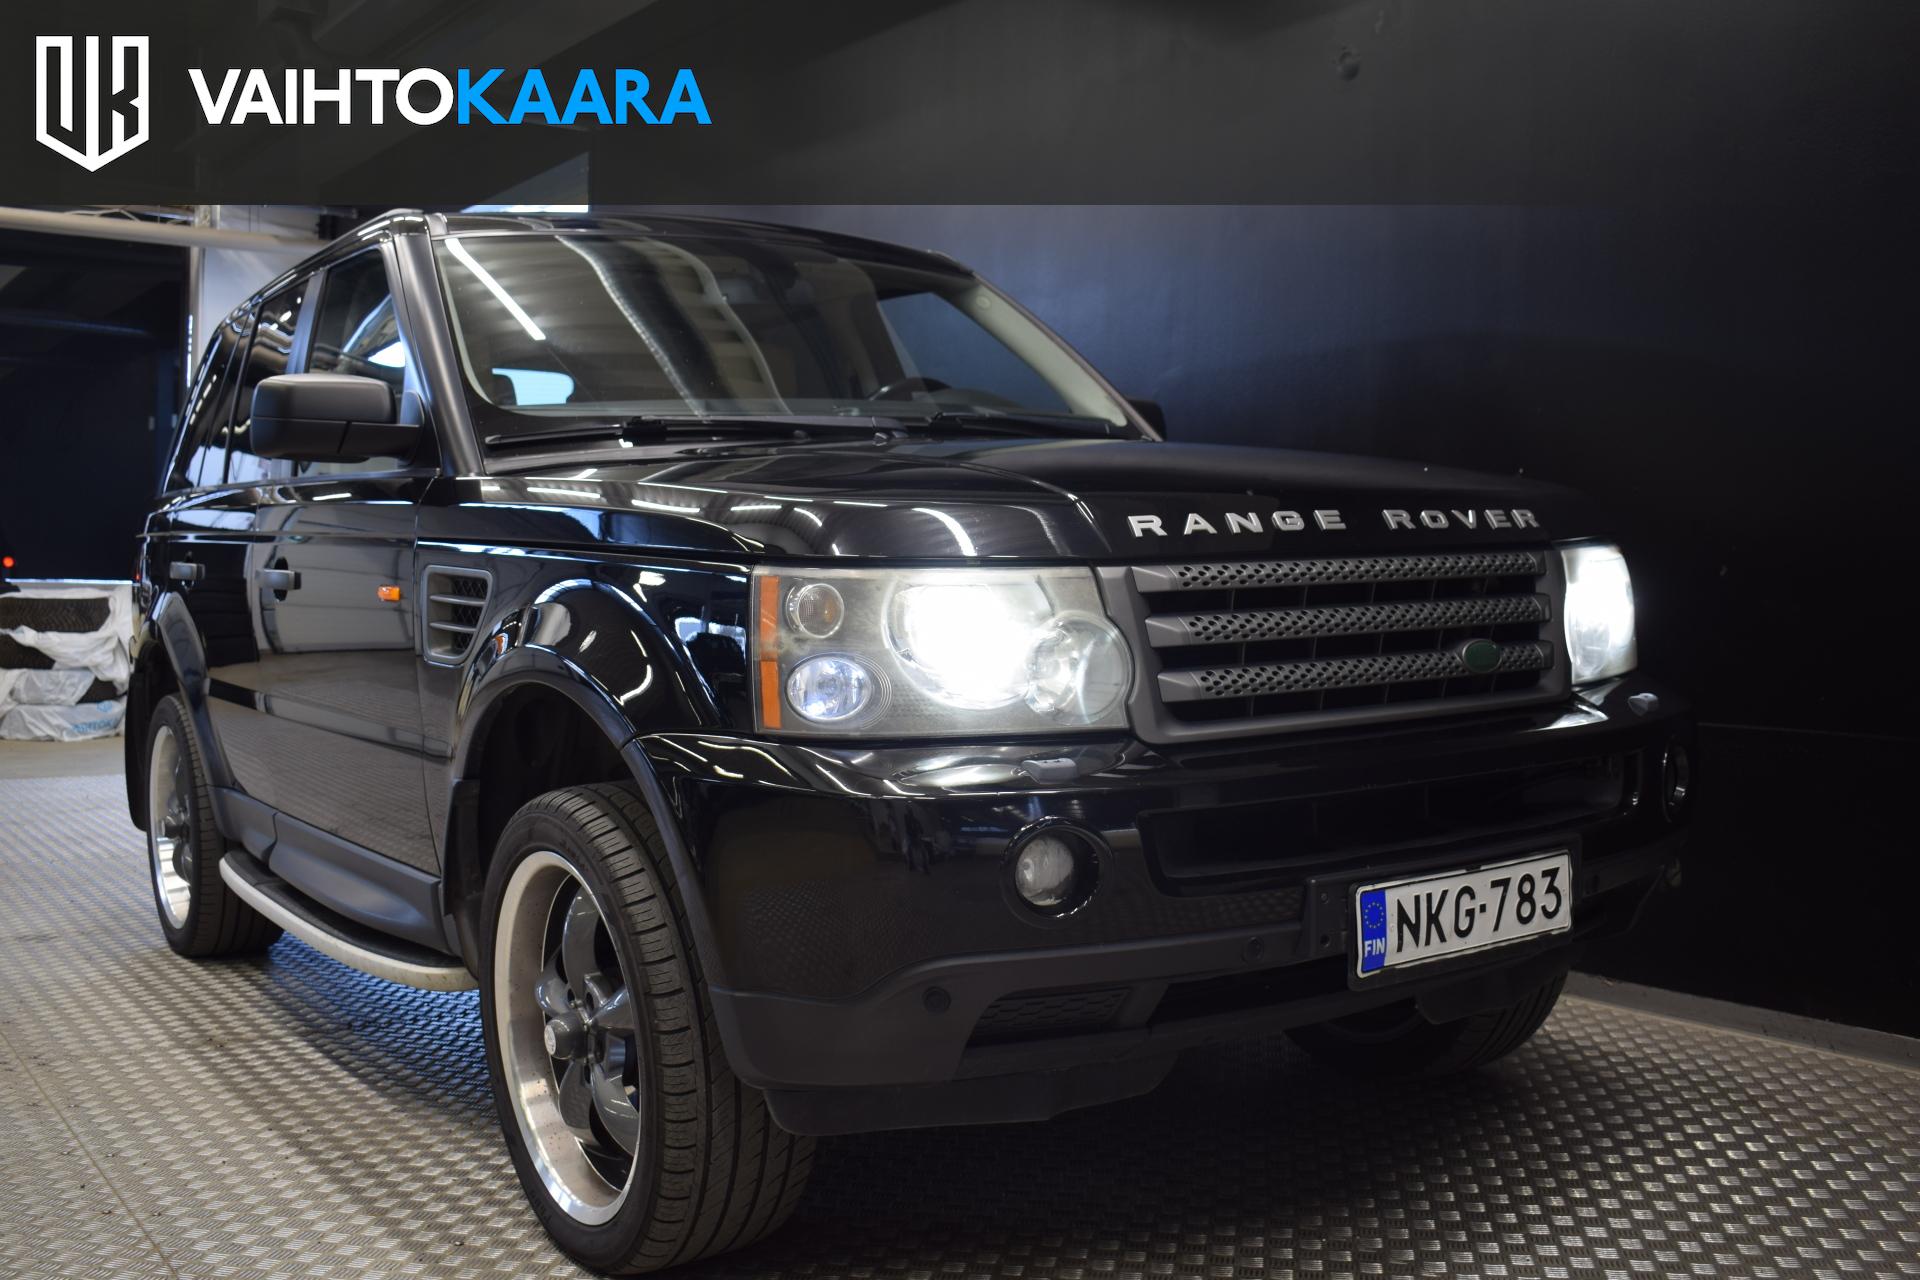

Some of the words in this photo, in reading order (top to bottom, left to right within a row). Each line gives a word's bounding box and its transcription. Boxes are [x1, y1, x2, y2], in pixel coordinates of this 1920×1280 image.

[1127, 510, 1346, 537] RANGE
[1382, 508, 1540, 530] ROVER
[1396, 866, 1562, 953] NKG-783
[1364, 937, 1386, 958] FIN
